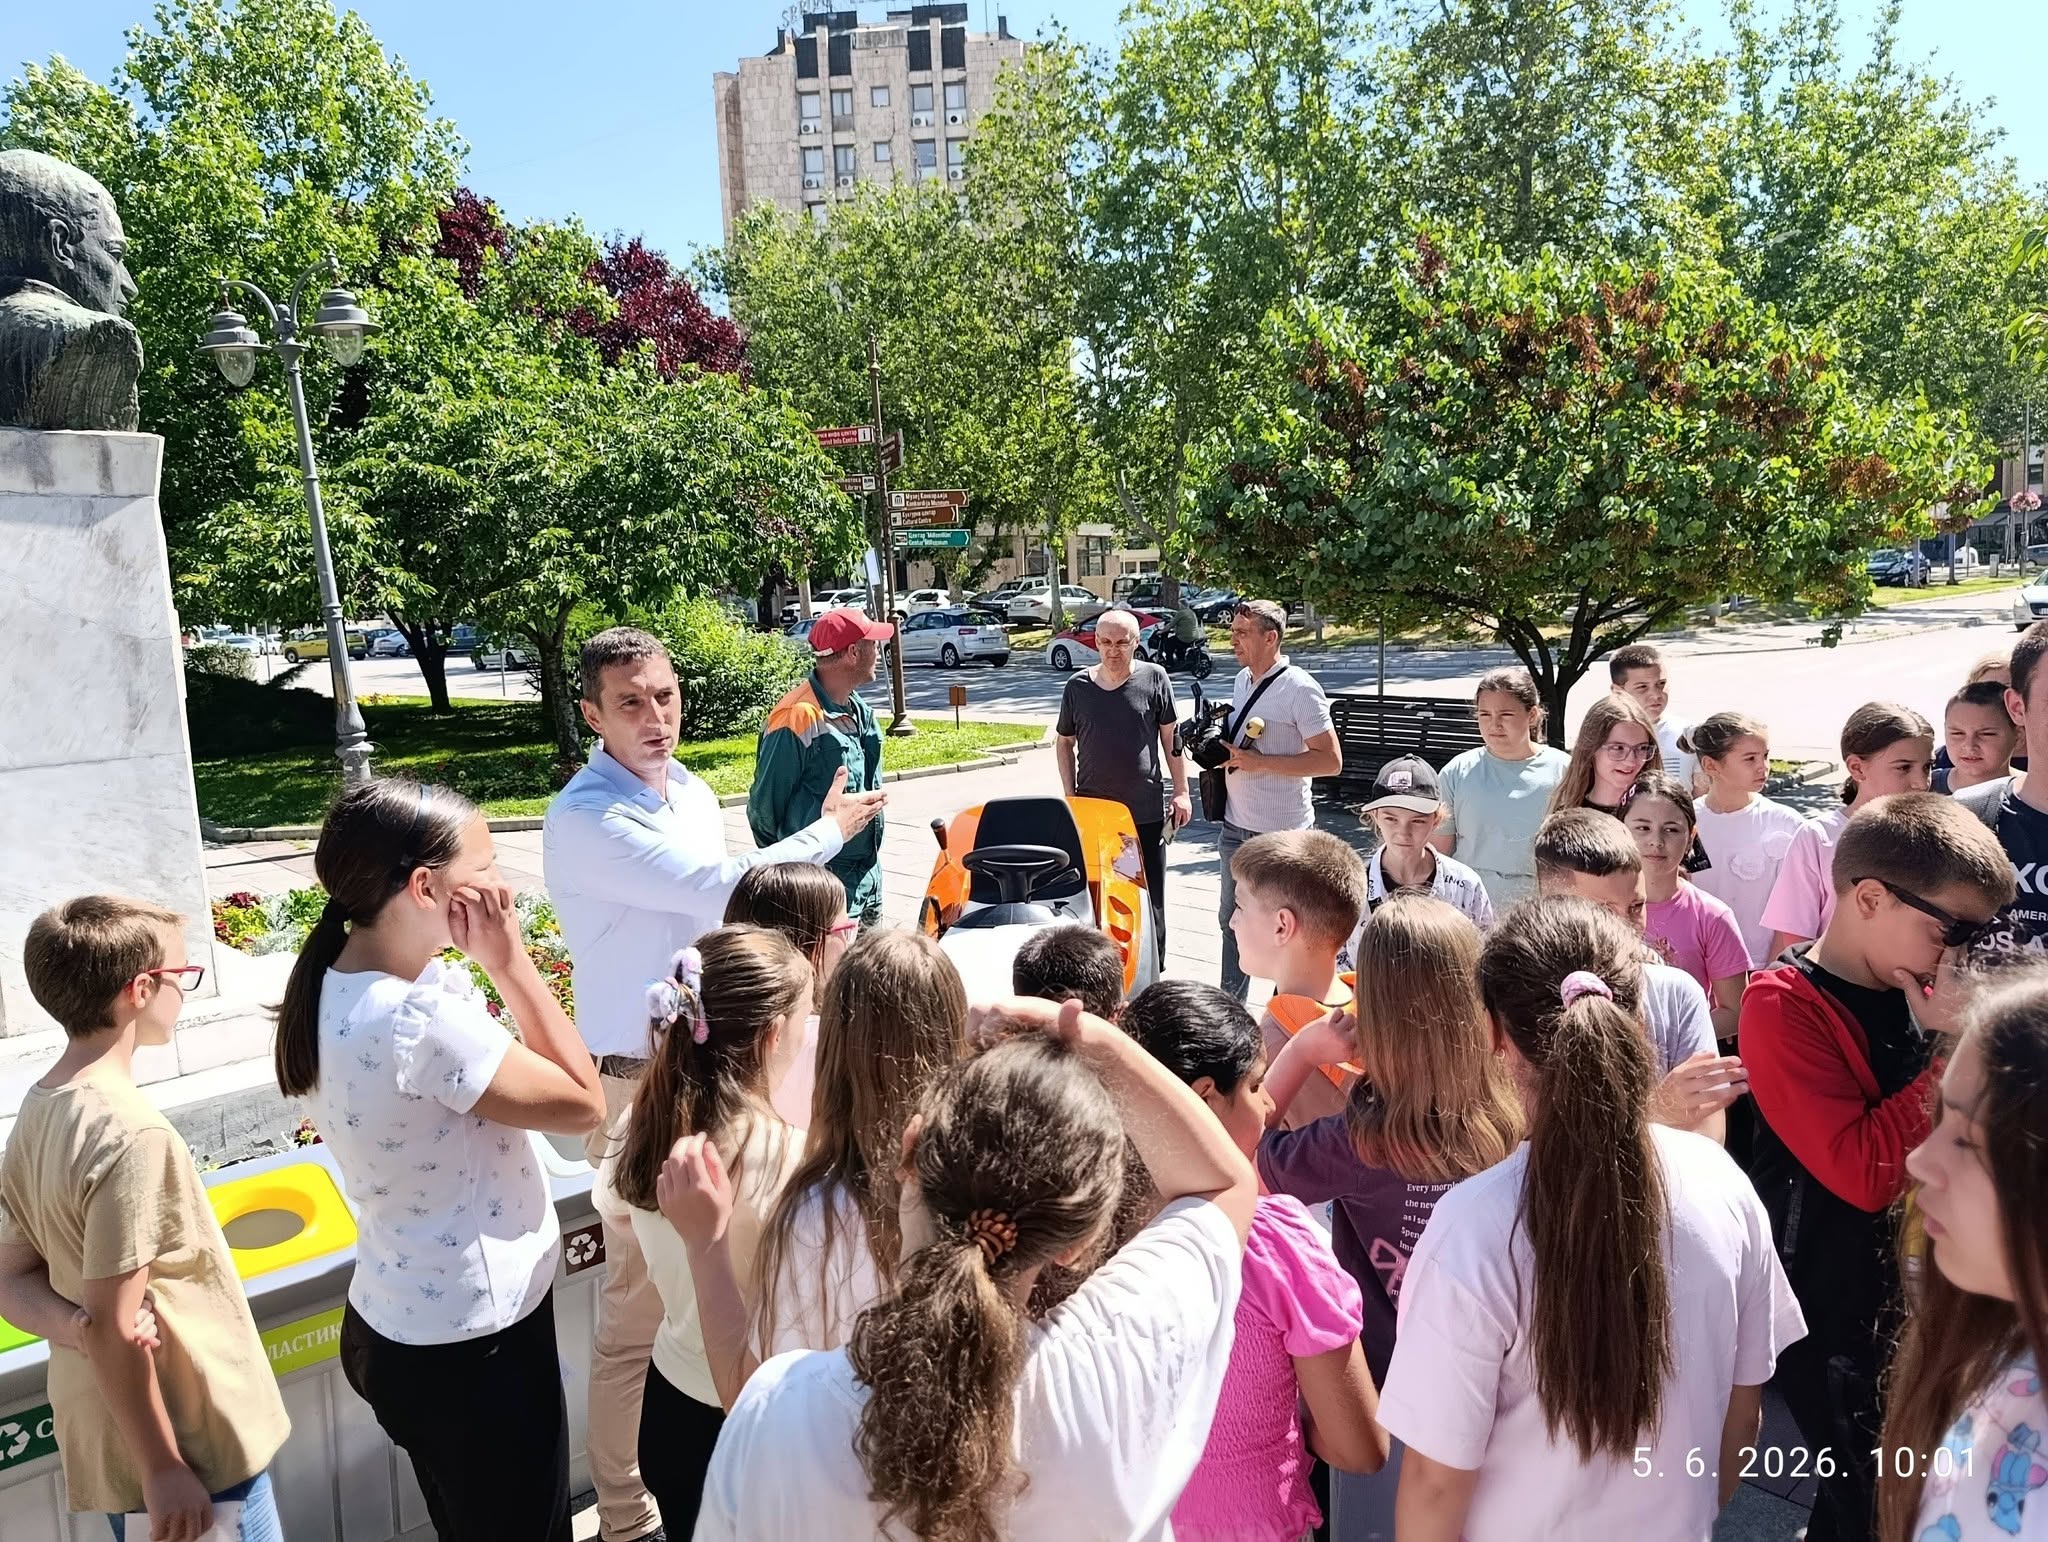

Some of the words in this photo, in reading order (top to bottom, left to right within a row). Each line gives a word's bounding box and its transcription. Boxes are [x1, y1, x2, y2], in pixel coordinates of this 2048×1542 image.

[845, 484, 861, 492] Library
[2008, 908, 2048, 921] AMER
[1407, 1183, 1429, 1194] Every
[1405, 1199, 1419, 1208] the
[1420, 1201, 1435, 1209] new
[1401, 1226, 1420, 1239] Spen
[267, 1321, 342, 1360] ЛАСТИК
